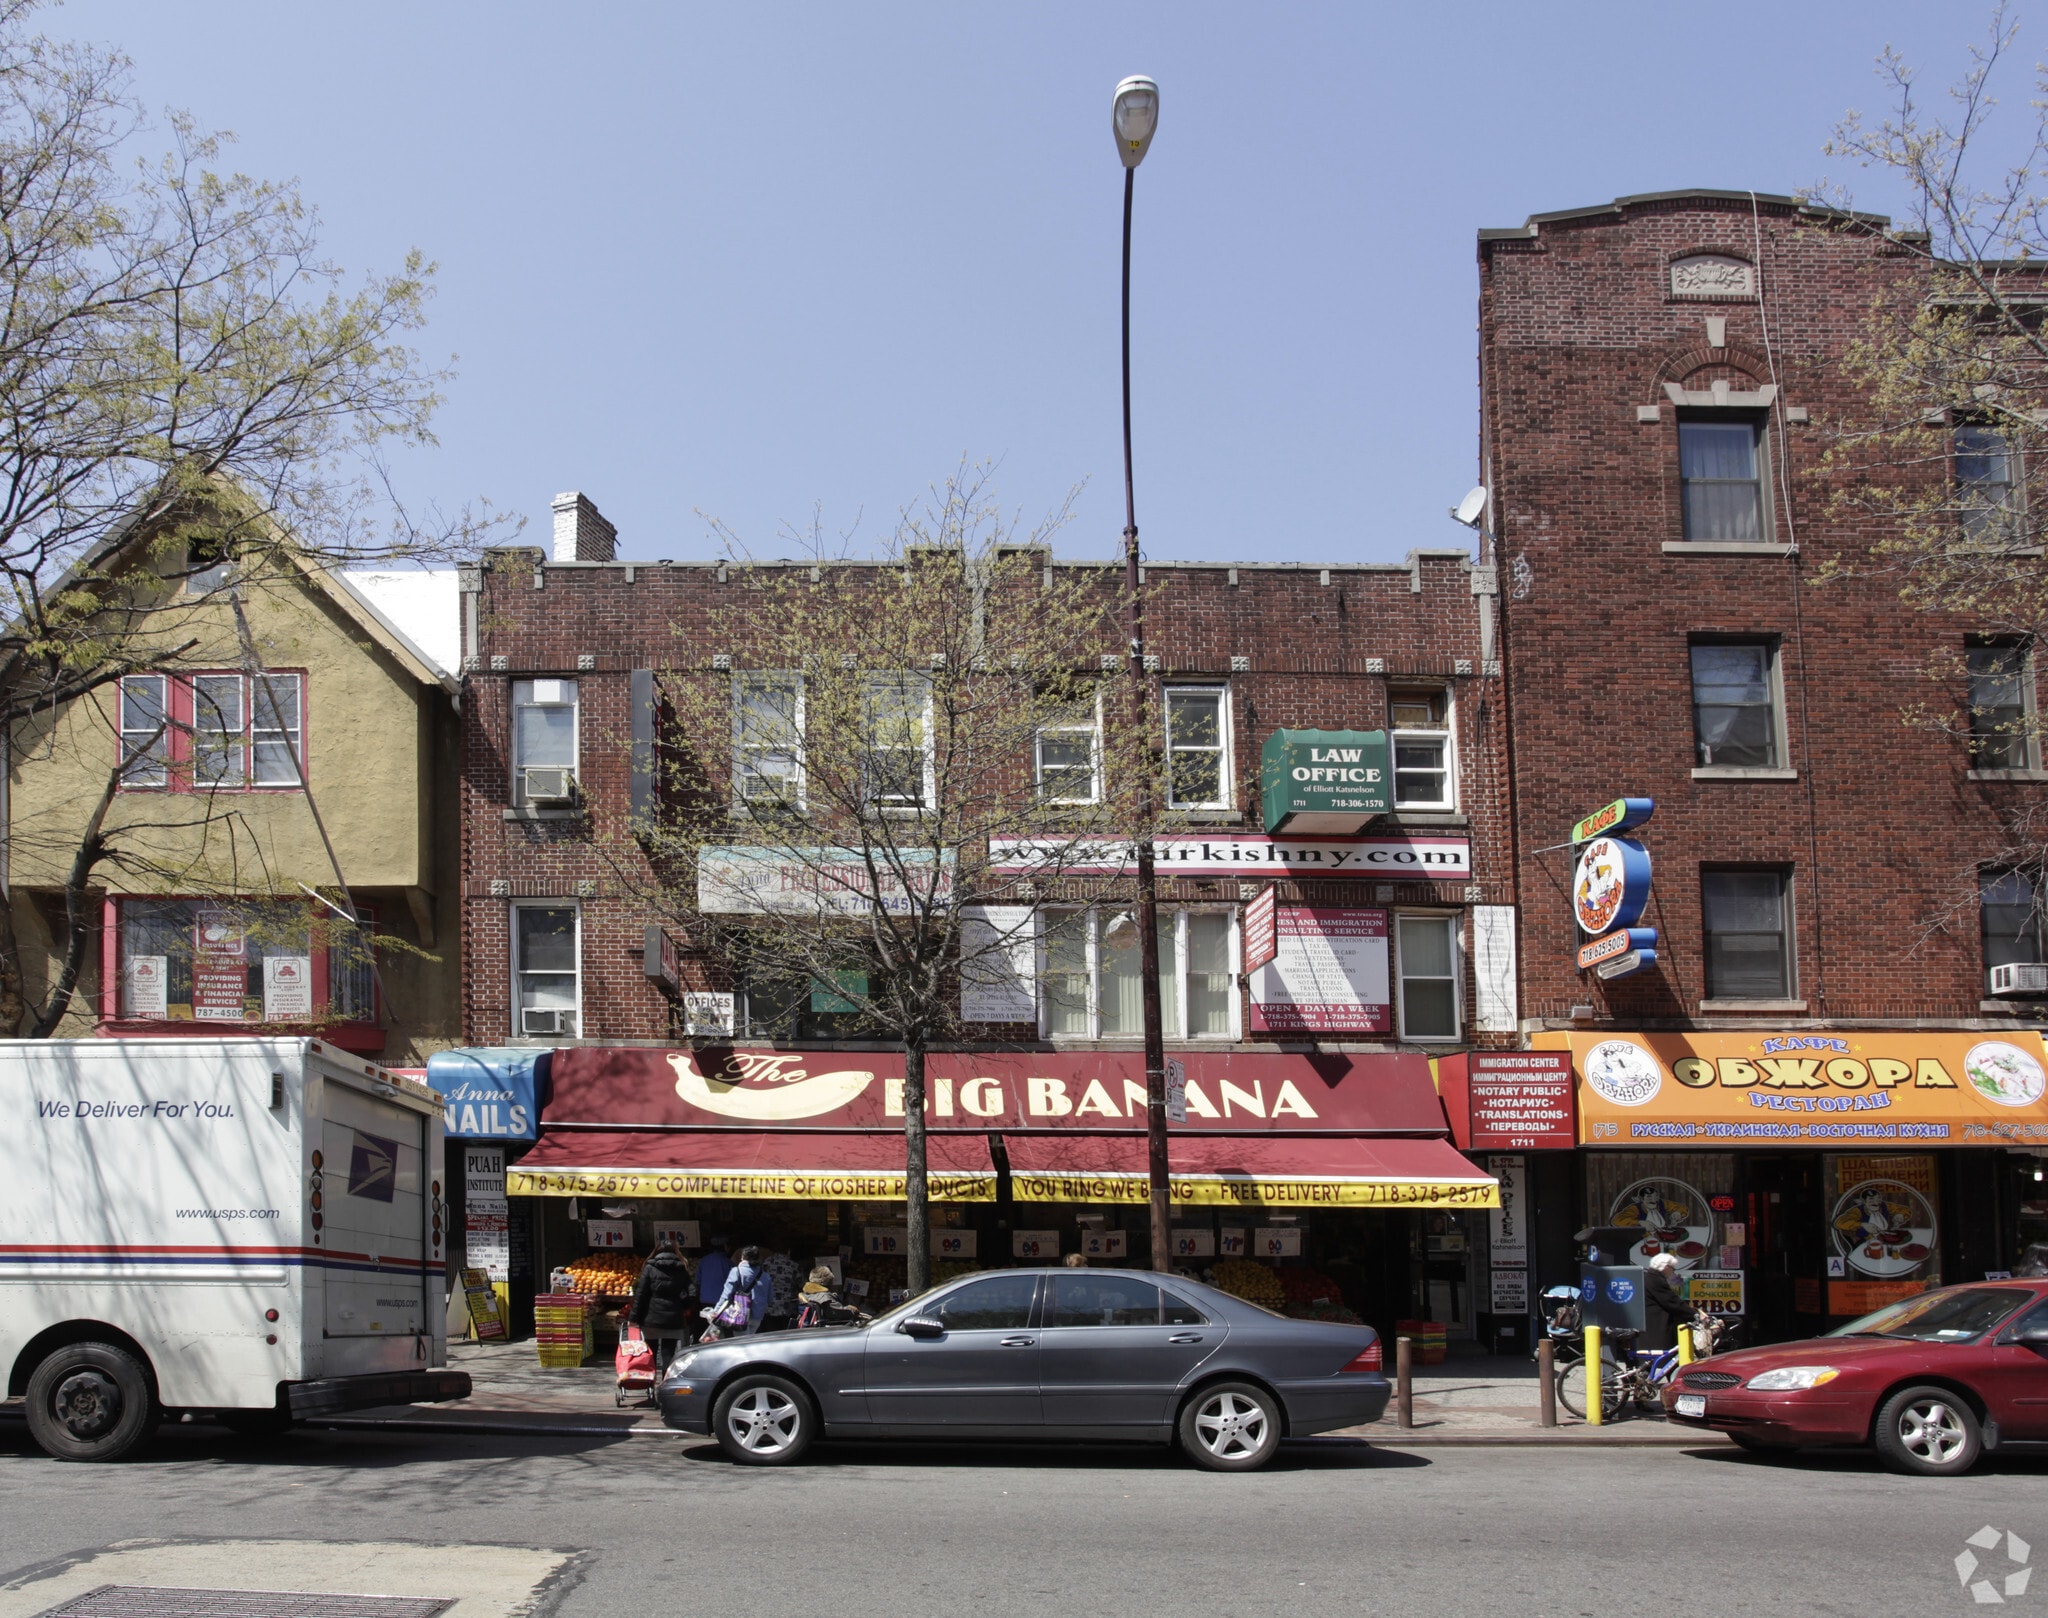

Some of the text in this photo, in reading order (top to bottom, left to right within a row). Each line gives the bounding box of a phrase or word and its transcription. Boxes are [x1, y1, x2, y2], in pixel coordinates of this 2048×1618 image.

[1311, 748, 1362, 762] LAW
[1292, 767, 1381, 782] OFFICE
[1313, 785, 1333, 793] Elliott
[1331, 799, 1384, 807] 718-306-1570
[1581, 805, 1617, 839] КАФЕ
[1578, 878, 1622, 930] OBZHORA
[198, 974, 242, 982] PROVIDING
[687, 997, 731, 1008] OFFICES
[196, 1009, 243, 1017] 787-4500
[1761, 1036, 1850, 1056] КАФЕ
[715, 1053, 808, 1083] The
[1479, 1058, 1559, 1068] IMMIGRATION CENTER
[1473, 1072, 1567, 1082] ИММИГРАЦИОННЫЙ ЦЕНТР
[1672, 1056, 1959, 1090] ОБЖОРА
[444, 1082, 515, 1101] Anna
[1478, 1087, 1562, 1096] NOTARY PUBLIC
[1591, 1072, 1658, 1102] OBZHORA
[885, 1077, 1004, 1118] BIG
[1489, 1099, 1549, 1108] НОТАРИУС
[1747, 1090, 1892, 1113] РЕСТОРАН
[39, 1101, 235, 1118] We Deliver For You.
[1479, 1110, 1563, 1119] TRANSLATIONS
[444, 1104, 527, 1135] NAILS
[1491, 1122, 1550, 1131] ПЕРЕВОДЫ
[1593, 1122, 1619, 1139] 1715
[1631, 1122, 1949, 1139] РУССКАЯ УКРАИНСКАЯ ВОСТОЧНАЯ КУХНЯ
[1511, 1138, 1535, 1146] 1711
[467, 1155, 501, 1173] PUAH
[468, 1179, 504, 1191] INSTITUTE
[517, 1175, 986, 1197] 718-375-2579 COMPLETE LINE OF KOSHER PDUCTS
[1021, 1179, 1491, 1203] YOU RING WE BNG FREE DELIVERY 718-375-2579
[1710, 1199, 1734, 1210] OPEN
[176, 1208, 281, 1221] www.usps.com
[1830, 1260, 1842, 1271] A
[376, 1298, 418, 1310] www.usps.com
[1685, 1300, 1742, 1313] ИВО
